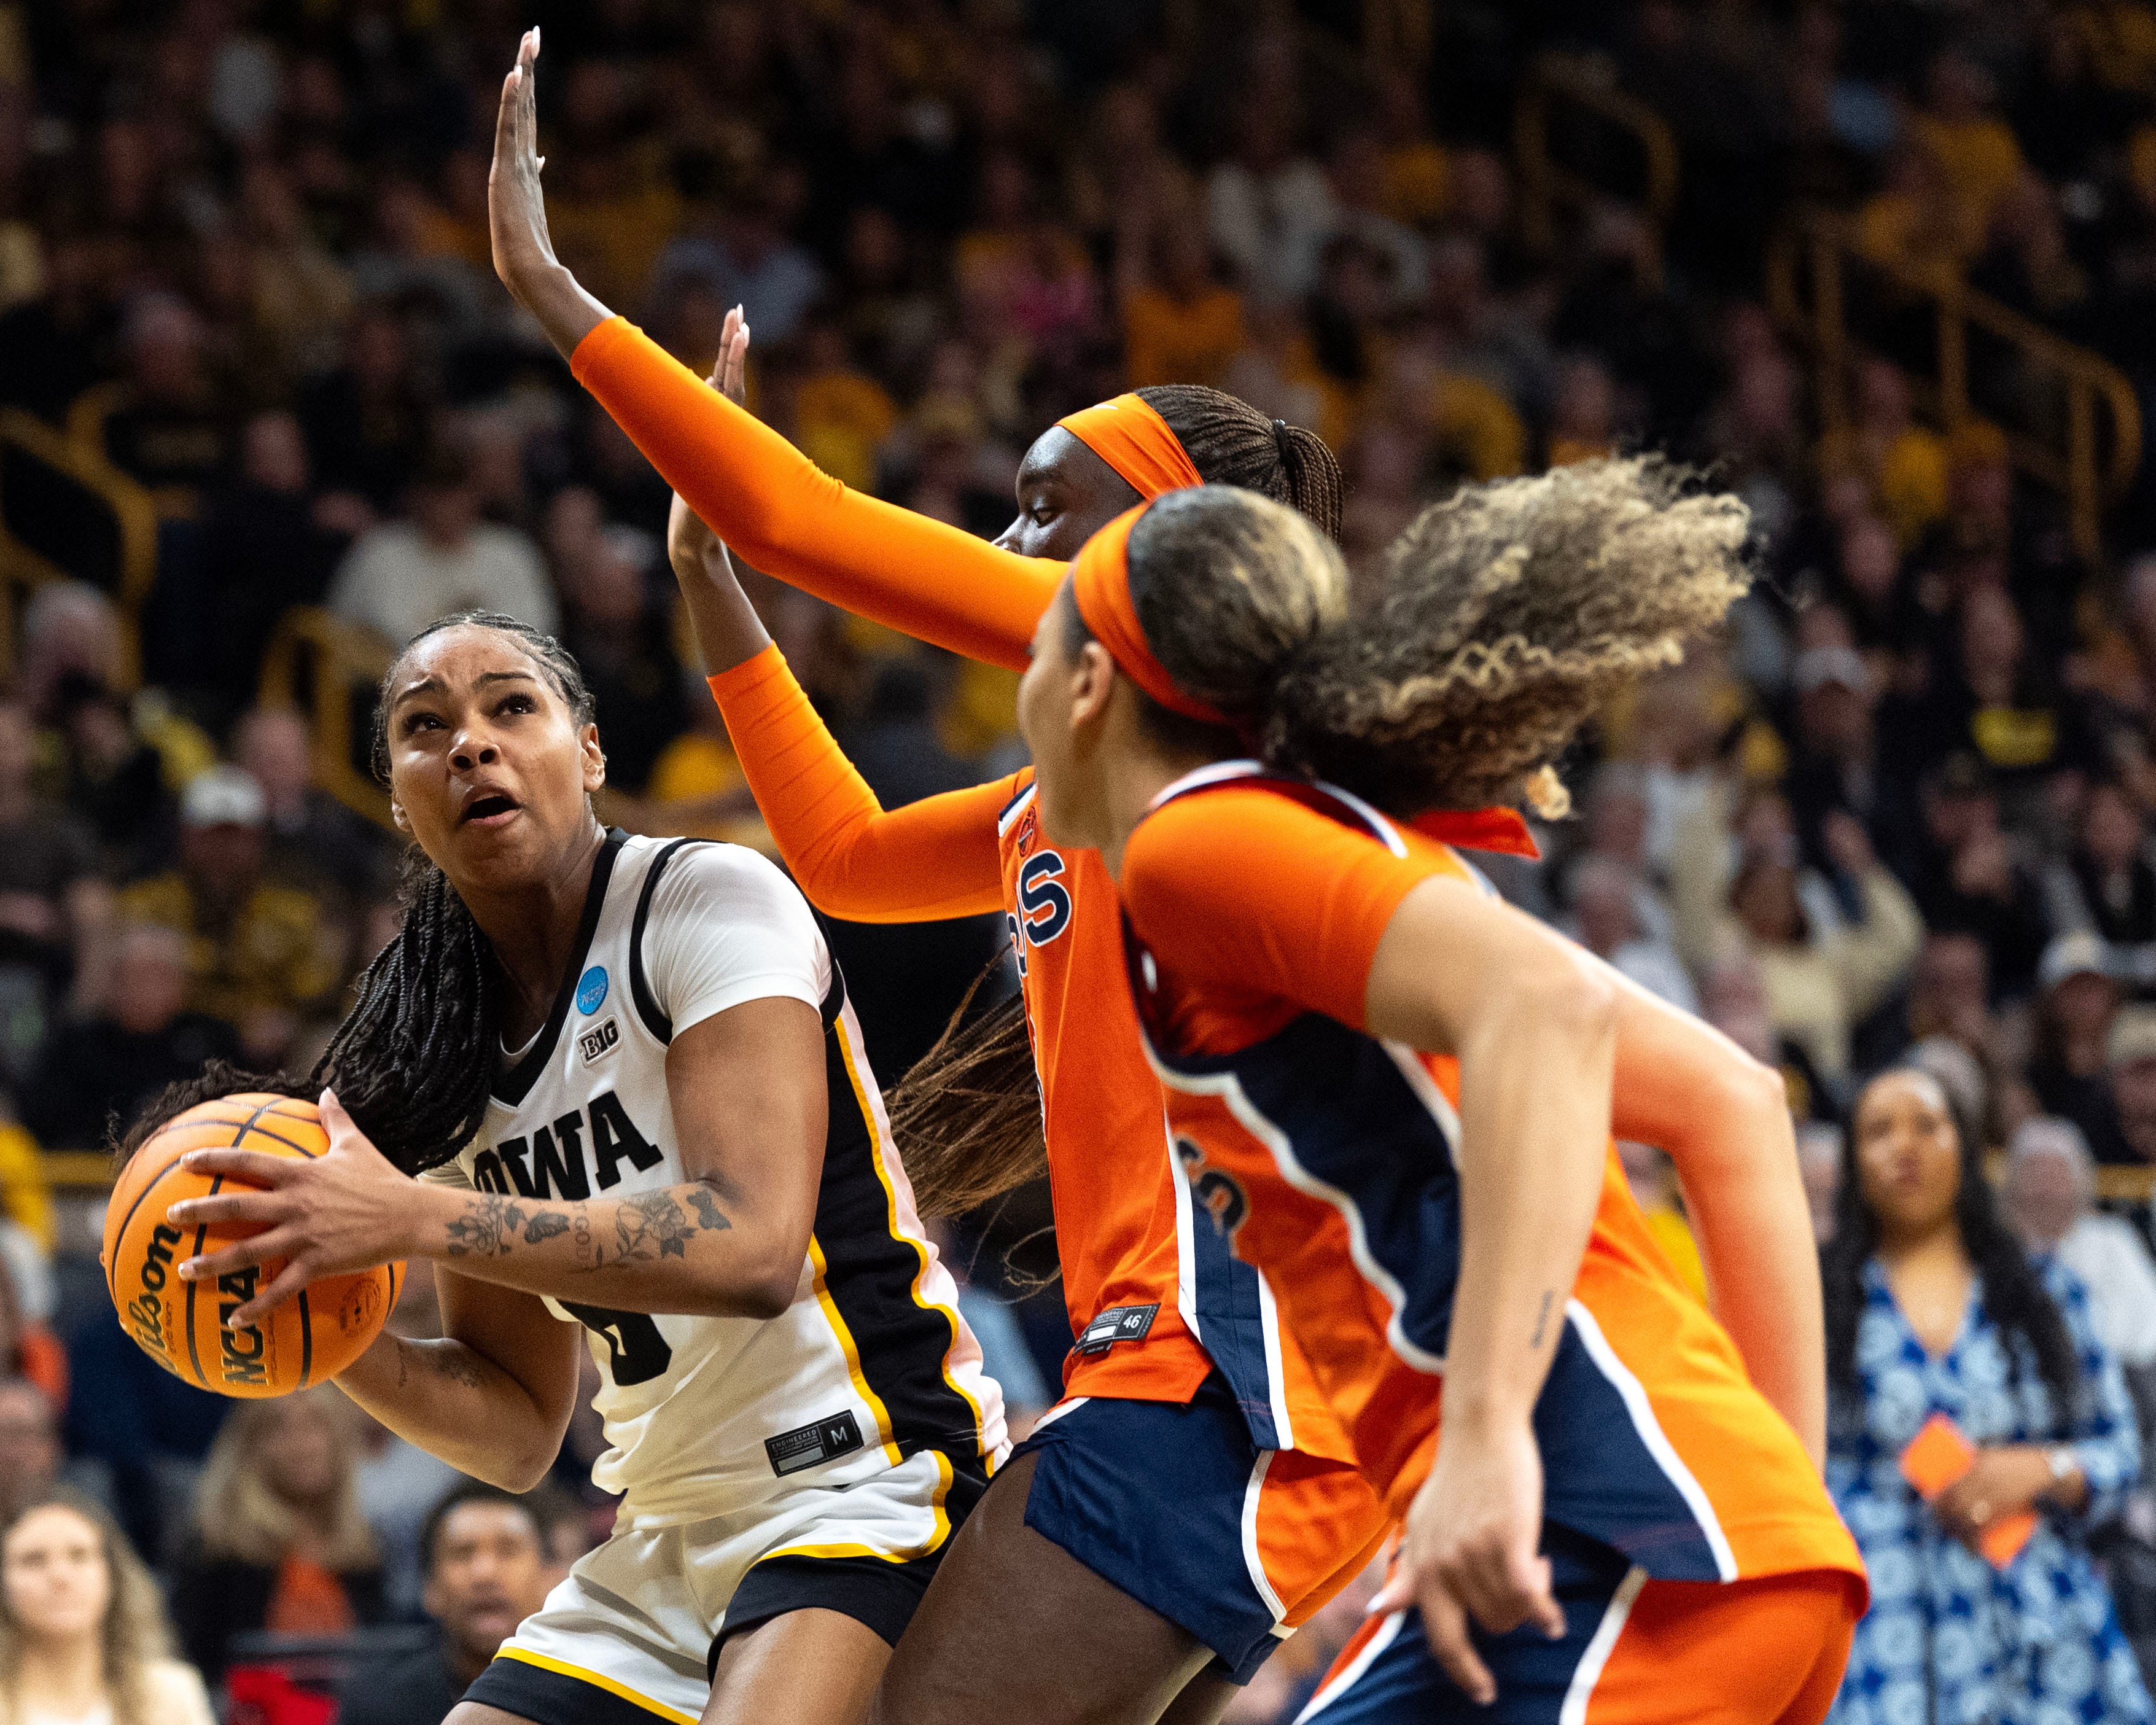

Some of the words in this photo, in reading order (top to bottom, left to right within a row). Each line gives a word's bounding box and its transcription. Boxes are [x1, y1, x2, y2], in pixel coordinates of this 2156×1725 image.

[1123, 1314, 1142, 1329] 46
[771, 1429, 817, 1450] ENGINEERED
[830, 1427, 848, 1445] M
